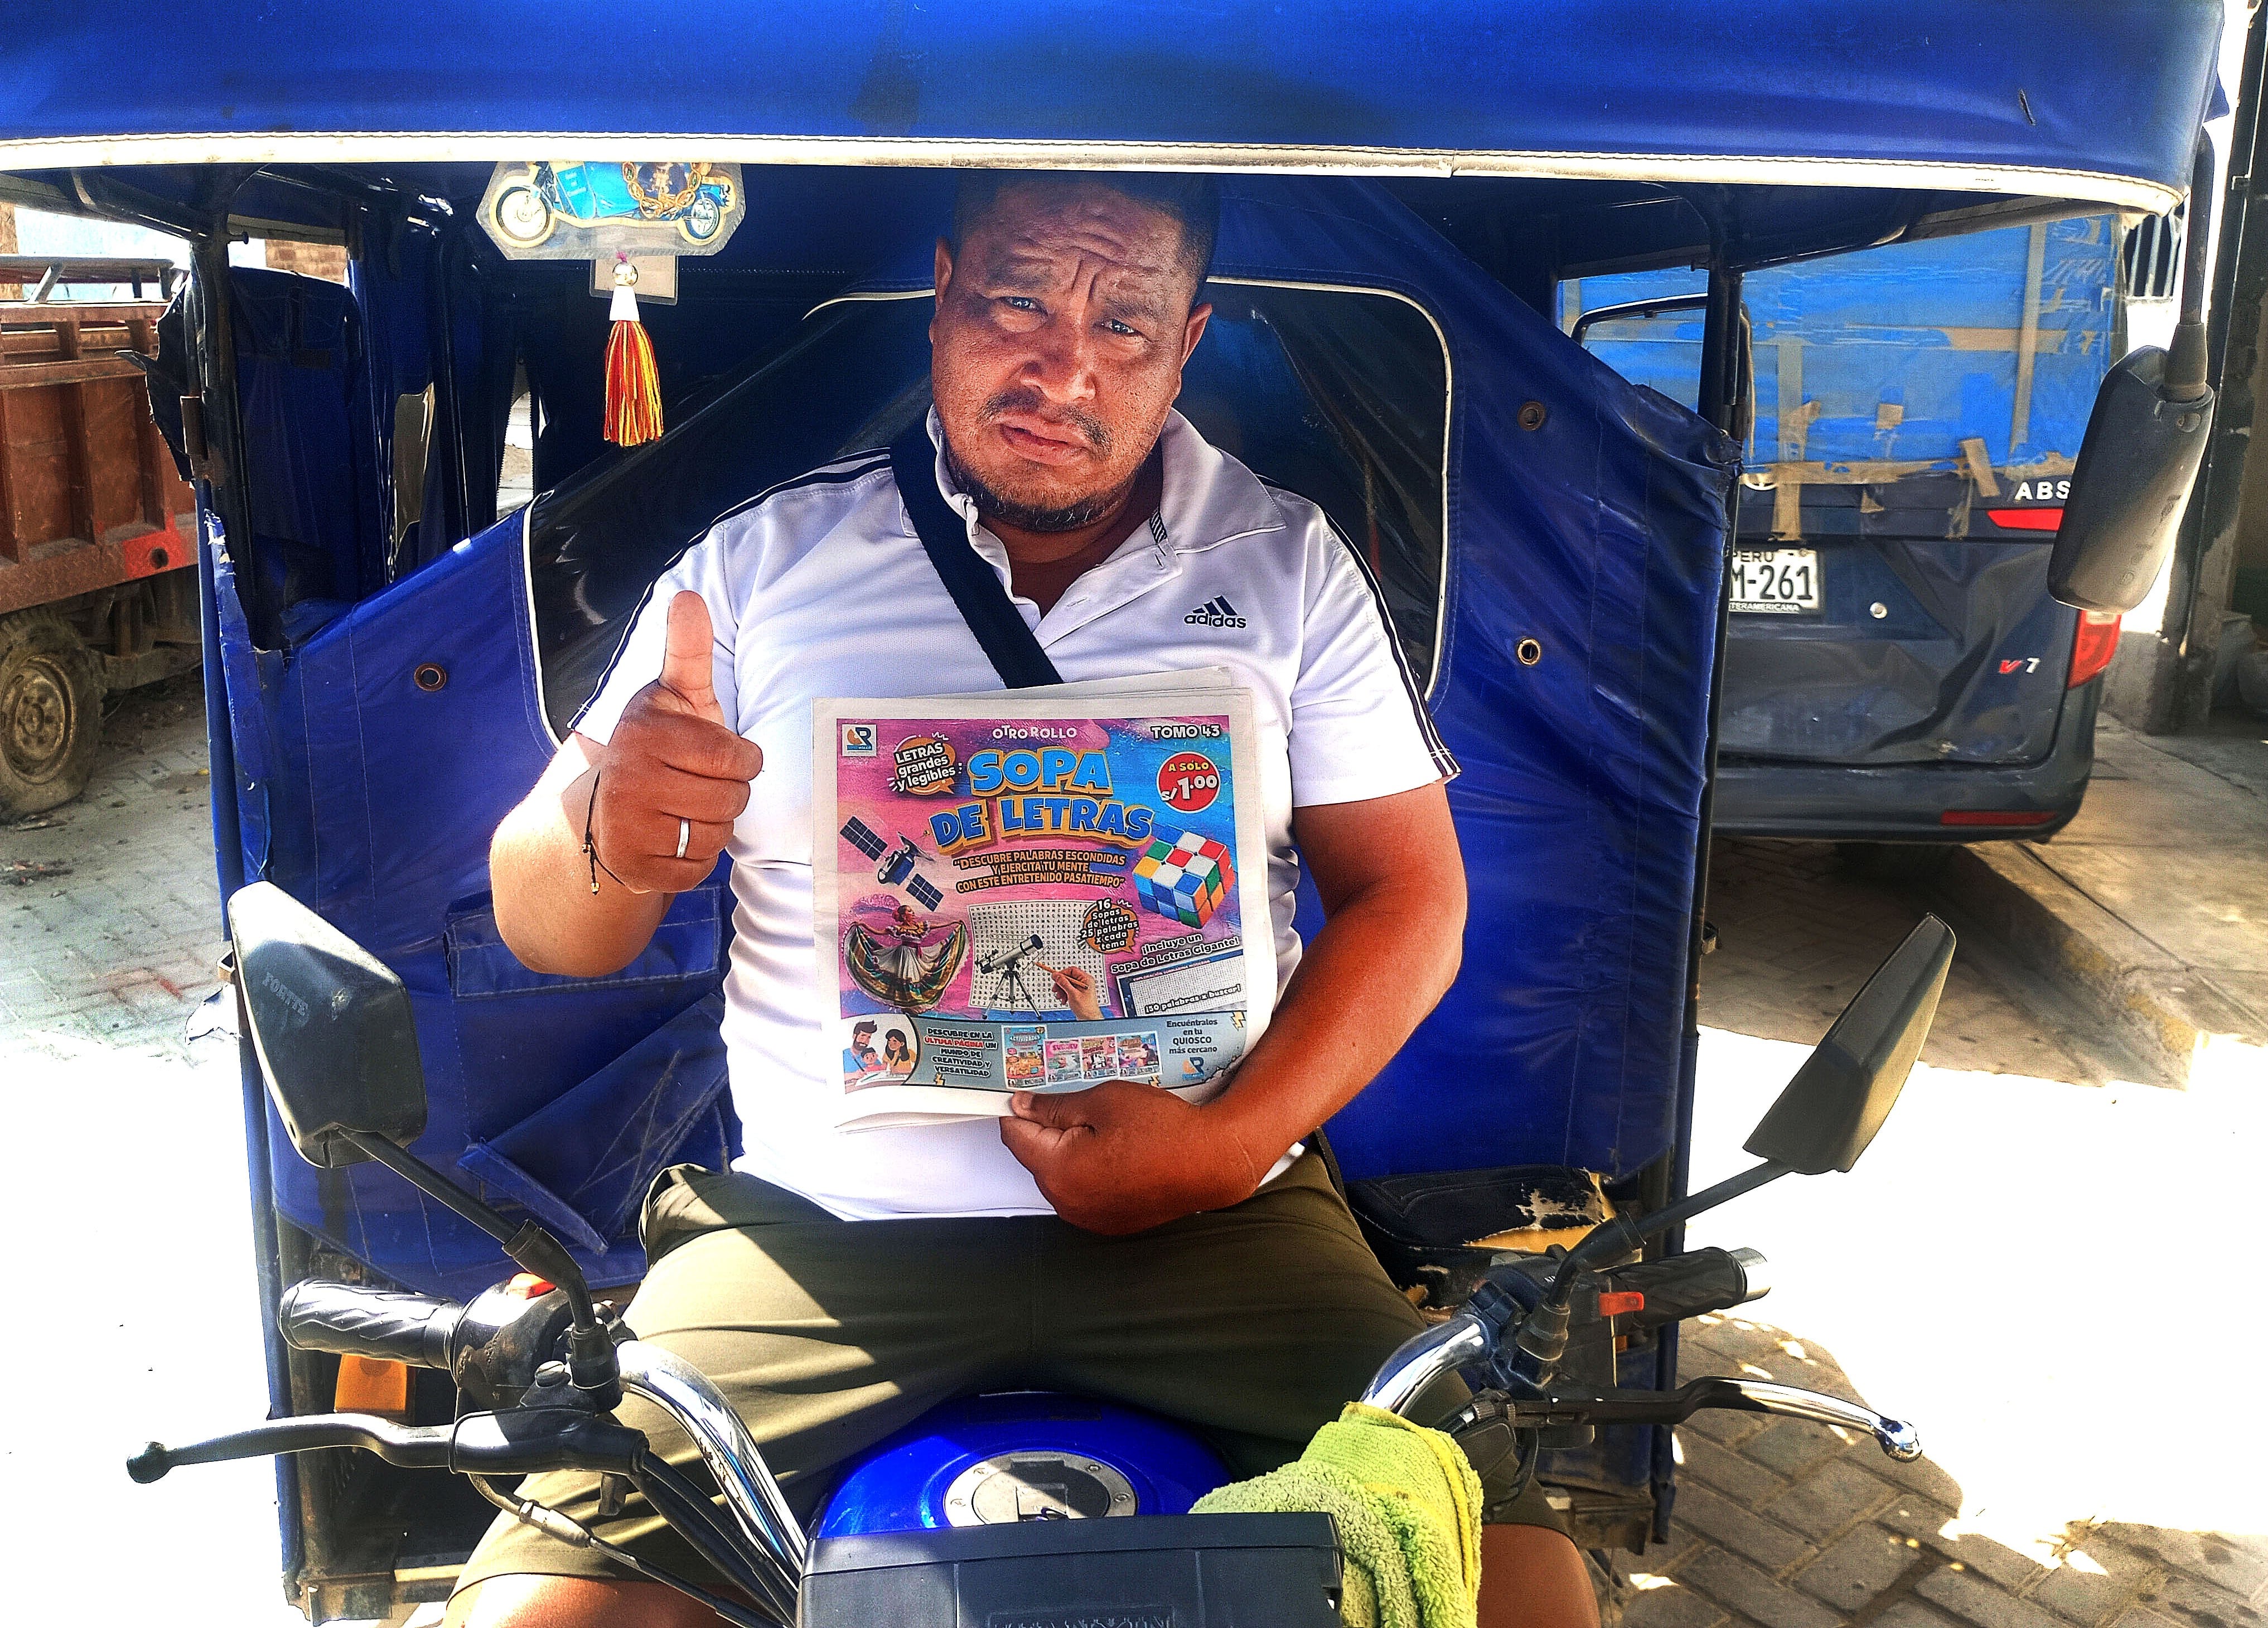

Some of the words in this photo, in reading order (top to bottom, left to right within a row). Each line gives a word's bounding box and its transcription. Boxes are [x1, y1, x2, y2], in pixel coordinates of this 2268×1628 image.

[2014, 480, 2071, 500] ABS
[1184, 613, 1247, 629] adidas
[993, 724, 1028, 740] OTRO
[1031, 726, 1077, 739] ROLLO
[1152, 726, 1198, 739] TOMO
[1202, 725, 1220, 737] 43
[894, 742, 944, 764] LETRAS
[898, 756, 948, 779] grandes
[970, 749, 1110, 791] SOPA
[1168, 763, 1177, 772] A
[897, 781, 905, 792] y
[908, 766, 956, 788] legibles
[930, 804, 984, 847] DE
[999, 797, 1155, 840] LETRAS
[1014, 851, 1063, 862] PALABRAS
[1066, 851, 1125, 865] ESCONDIDAS
[992, 865, 1000, 875] Y
[1001, 862, 1042, 873] EJERCITA
[1043, 862, 1055, 871] TU
[1057, 862, 1089, 872] MENTE
[957, 881, 976, 893] CON
[978, 877, 1000, 888] ESTE
[1002, 873, 1062, 885] ENTRETENIDO
[1097, 898, 1111, 910] 16
[1092, 909, 1120, 919] Sopas
[1101, 915, 1129, 925] letras
[1082, 929, 1094, 938] 25
[1097, 921, 1138, 936] palabras
[1105, 931, 1127, 941] cada
[1101, 940, 1125, 949] tema
[1187, 934, 1203, 943] un
[1111, 963, 1139, 974] Sopa
[1141, 958, 1154, 967] de
[1157, 950, 1191, 964] Letras
[1193, 936, 1240, 954] Gigante!
[1162, 994, 1200, 1011] palabras
[1208, 984, 1241, 999] buscar!
[1167, 1019, 1218, 1027] Encuéntralos
[927, 1027, 969, 1038] DESCUBRE
[1173, 1036, 1212, 1046] QUIOSCO
[941, 1048, 970, 1057] MUNDO
[932, 1056, 983, 1067] CREATIVIDAD
[935, 1065, 990, 1076] VERSATILIDAD
